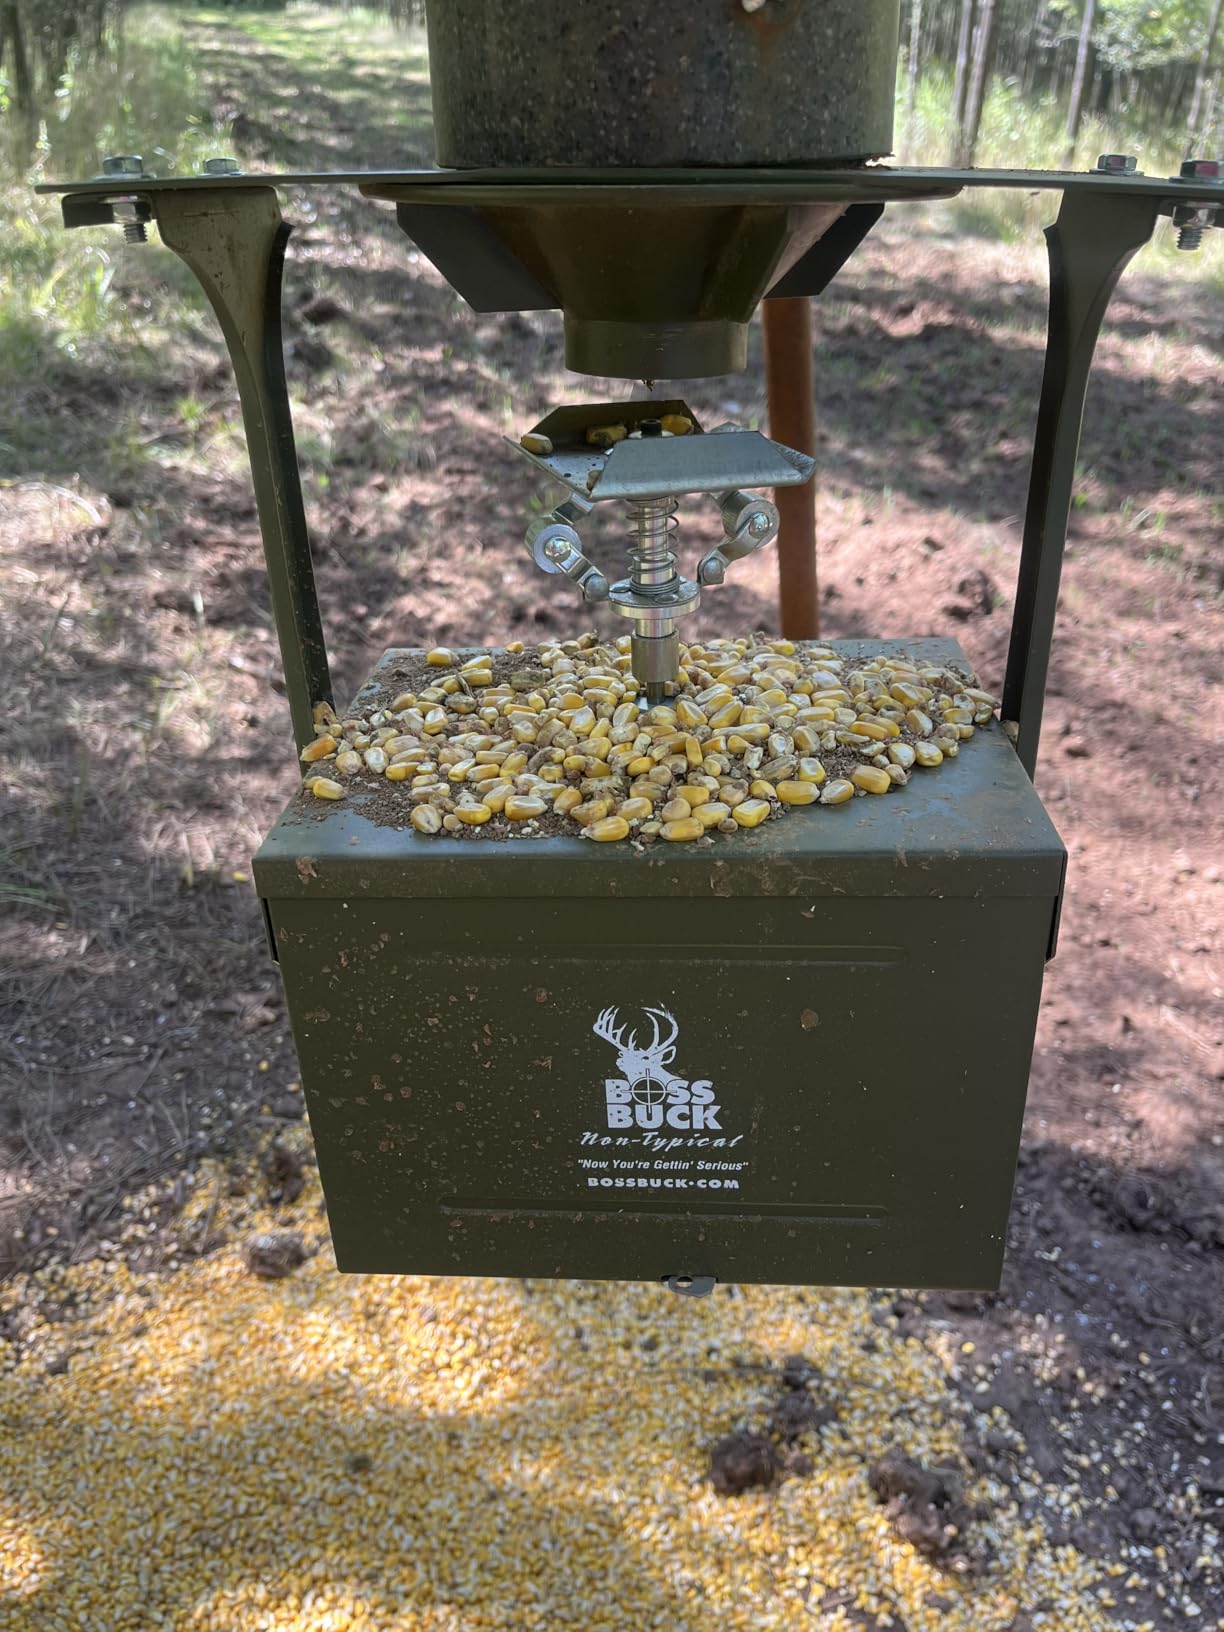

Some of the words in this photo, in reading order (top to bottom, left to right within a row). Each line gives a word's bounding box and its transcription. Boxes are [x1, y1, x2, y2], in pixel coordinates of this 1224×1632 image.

[605, 1077, 716, 1105] BOSS
[607, 1104, 723, 1129] BUCK
[579, 1131, 744, 1152] Non-Typical
[577, 1159, 609, 1169] "Now
[612, 1159, 650, 1169] You're
[653, 1160, 694, 1170] Gettin'
